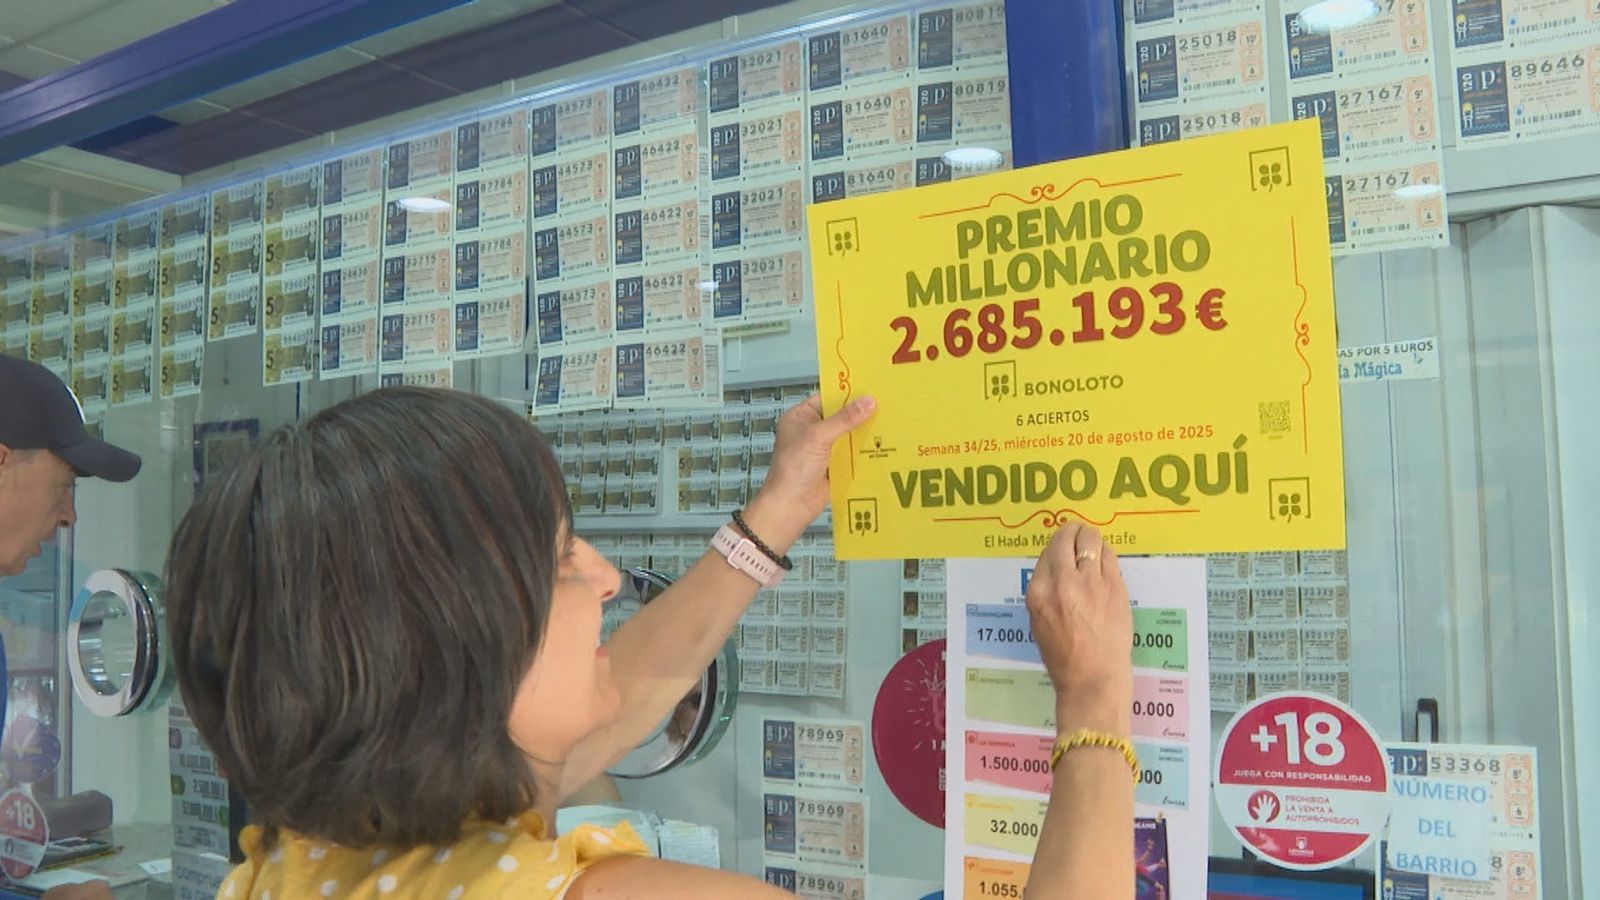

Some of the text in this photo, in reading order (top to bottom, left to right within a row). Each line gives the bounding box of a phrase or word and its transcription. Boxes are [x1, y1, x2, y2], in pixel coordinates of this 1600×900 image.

[1180, 31, 1237, 50] 25018
[1511, 54, 1585, 77] 89646
[955, 80, 1006, 96] 80819
[1340, 85, 1402, 107] 27167
[845, 96, 892, 114] 81640
[1184, 112, 1240, 131] 25018
[848, 168, 895, 185] 81640
[1346, 172, 1409, 191] 27167
[957, 194, 1143, 259] PREMIO
[744, 259, 783, 275] 32021
[906, 229, 1211, 308] MILLONARIO
[1357, 346, 1381, 357] POR
[1384, 346, 1391, 355] 5
[1394, 340, 1434, 353] EUROS
[1354, 361, 1403, 380] Mágica
[1024, 375, 1124, 396] BONOLOTO
[1016, 410, 1090, 426] 6 ACIERTOS
[918, 424, 1213, 457] Semana 34/25, miércoles 20 de agosto de 2025
[891, 433, 1249, 508] VENDIDO AQUÍ
[984, 535, 994, 548] El
[1000, 534, 1028, 547] Hada
[1102, 531, 1137, 546] etafe
[798, 727, 844, 742] 78969
[1250, 711, 1346, 767] +18
[980, 755, 1049, 774] 1.500.000
[1431, 756, 1501, 773] 53368
[1233, 769, 1372, 783] JUEGA CON RESPONSABILIDAD
[1393, 776, 1486, 804] NÚMERO
[1285, 795, 1330, 804] PROHIBIDA
[798, 801, 844, 817] 78969
[1299, 806, 1325, 814] VENTA
[990, 819, 1039, 837] 32.000
[1285, 815, 1360, 826] AUTOPROHIBIDOS
[1418, 818, 1456, 838] DEL
[1396, 852, 1477, 877] BARRIO
[799, 877, 845, 893] 78969
[979, 881, 1026, 900] 1.055.
